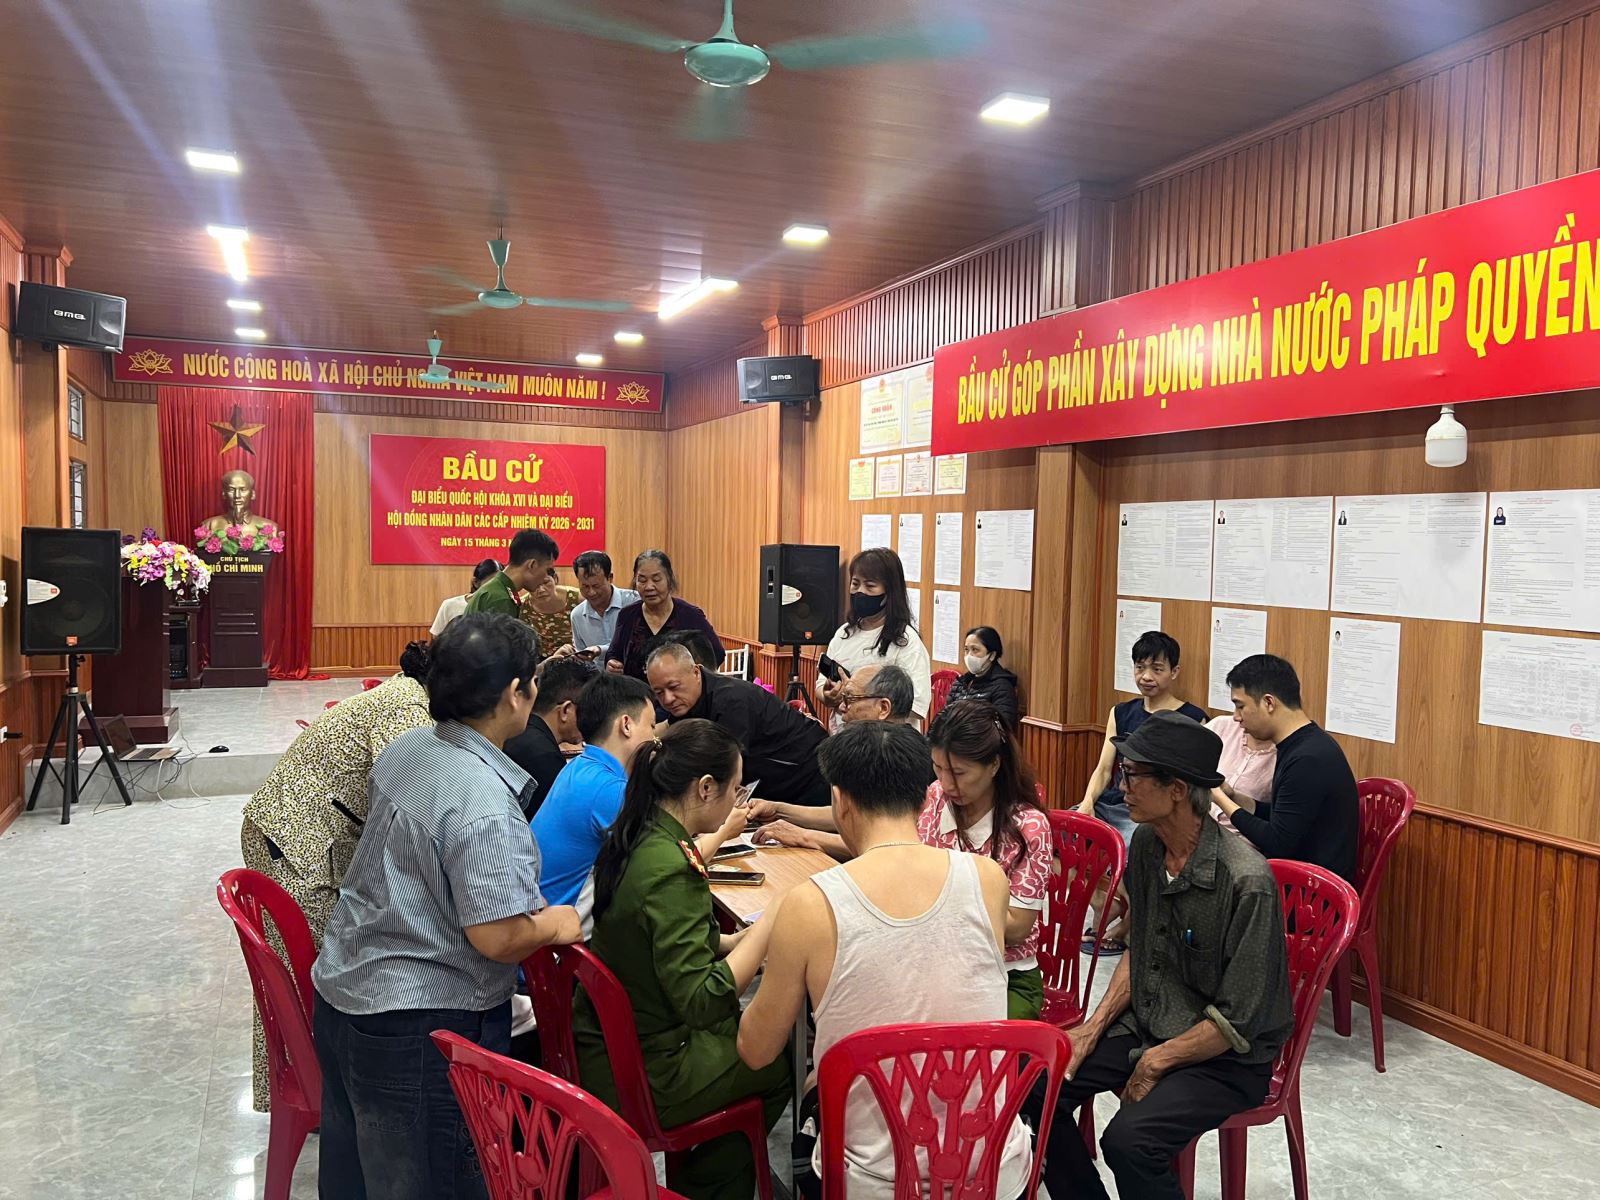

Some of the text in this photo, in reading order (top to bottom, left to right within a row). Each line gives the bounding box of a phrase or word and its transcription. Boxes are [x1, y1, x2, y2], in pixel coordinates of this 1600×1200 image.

[958, 212, 1600, 424] BẦU CỬ GÓP PHẦN XÂY DỰNG NHÀ NƯỚC PHÁP QUYỀN
[183, 348, 229, 378] NƯỚC
[234, 352, 277, 383] CỘNG
[281, 356, 313, 383] HOÀ
[317, 359, 339, 384] XÃ
[344, 360, 368, 389] HỘI
[373, 360, 403, 388] CHỦ
[455, 366, 483, 395] VIỆT
[523, 372, 563, 398] MUÔN
[566, 375, 598, 400] NĂM
[443, 450, 544, 484] BẦU CỬ
[411, 490, 426, 506] ĐẠI
[449, 487, 471, 506] QUỐC
[473, 489, 487, 508] HỘI
[489, 490, 511, 507] KHÓA
[512, 493, 526, 507] XVI
[528, 491, 538, 507] VÀ
[539, 494, 553, 510] ĐẠI
[387, 509, 402, 528] HỘI
[404, 508, 427, 526] ĐỒNG
[429, 510, 453, 527] NHÂN
[455, 511, 472, 527] DÂN
[474, 512, 490, 528] CÁC
[492, 510, 509, 528] CẤP
[550, 516, 570, 530] 2026
[576, 517, 595, 530] 2031
[440, 536, 462, 547] NGÀY
[464, 538, 474, 547] 15
[474, 536, 500, 548] THÁNG
[501, 538, 507, 548] 3
[240, 564, 264, 573] MINH
